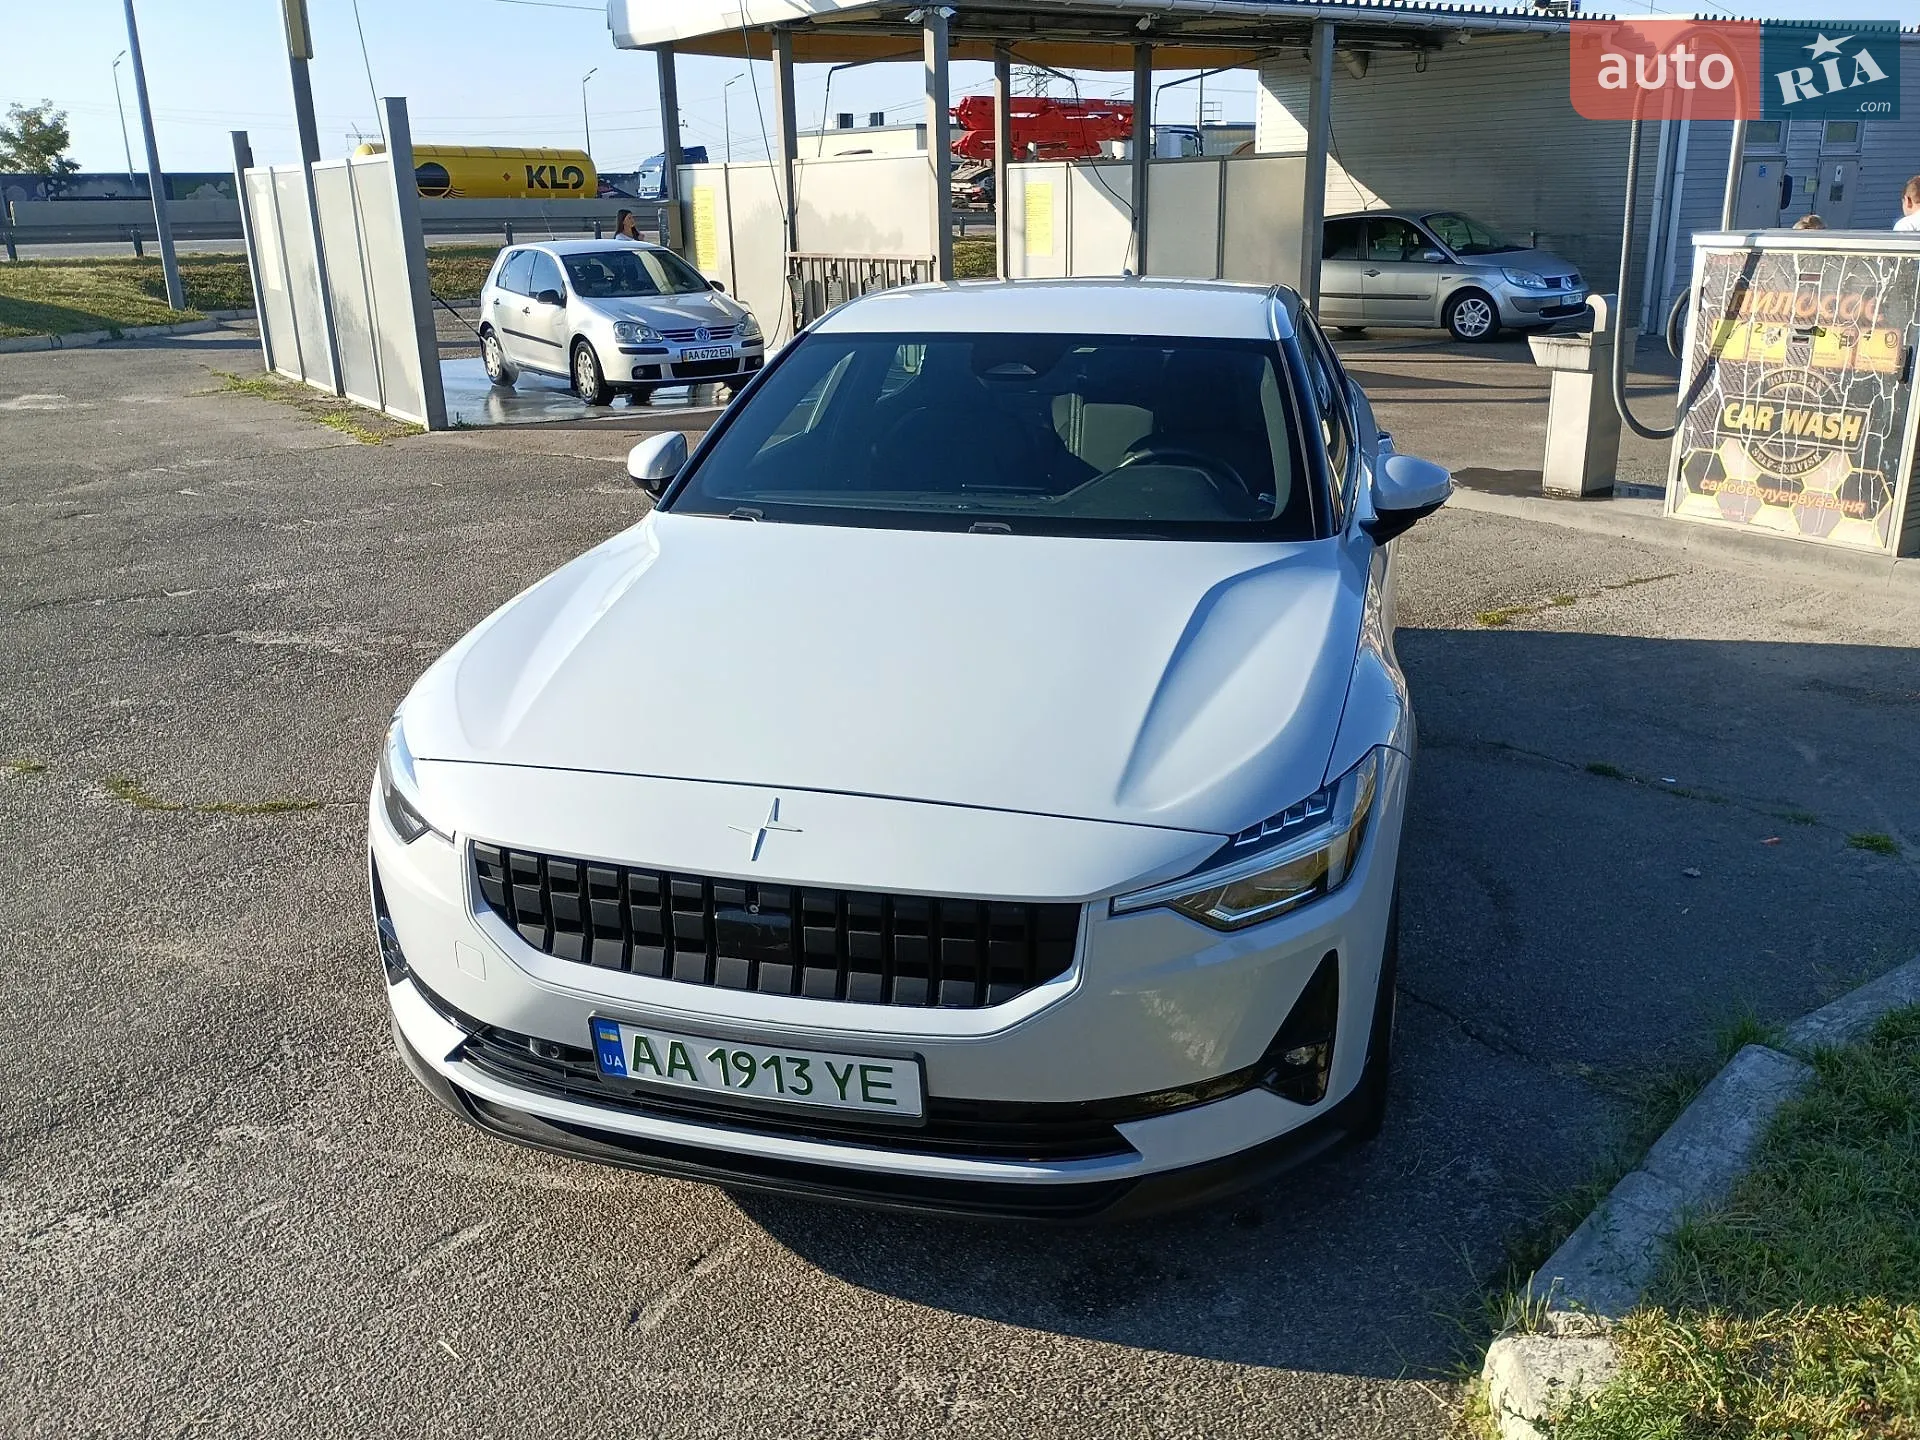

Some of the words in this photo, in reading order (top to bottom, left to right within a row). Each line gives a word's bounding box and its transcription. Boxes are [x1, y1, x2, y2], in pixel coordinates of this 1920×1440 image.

[525, 165, 585, 189] KLO
[1729, 289, 1884, 322] ПИЛОСОС
[688, 350, 700, 360] AA
[700, 349, 719, 359] 6722
[719, 348, 731, 358] EH
[1723, 402, 1775, 432] CAR
[1780, 408, 1863, 442] WASH
[1700, 478, 1868, 513] самообслуговування
[603, 1053, 624, 1069] UA
[631, 1033, 699, 1082] AA
[706, 1047, 814, 1096] 1913
[823, 1060, 898, 1106] YE
